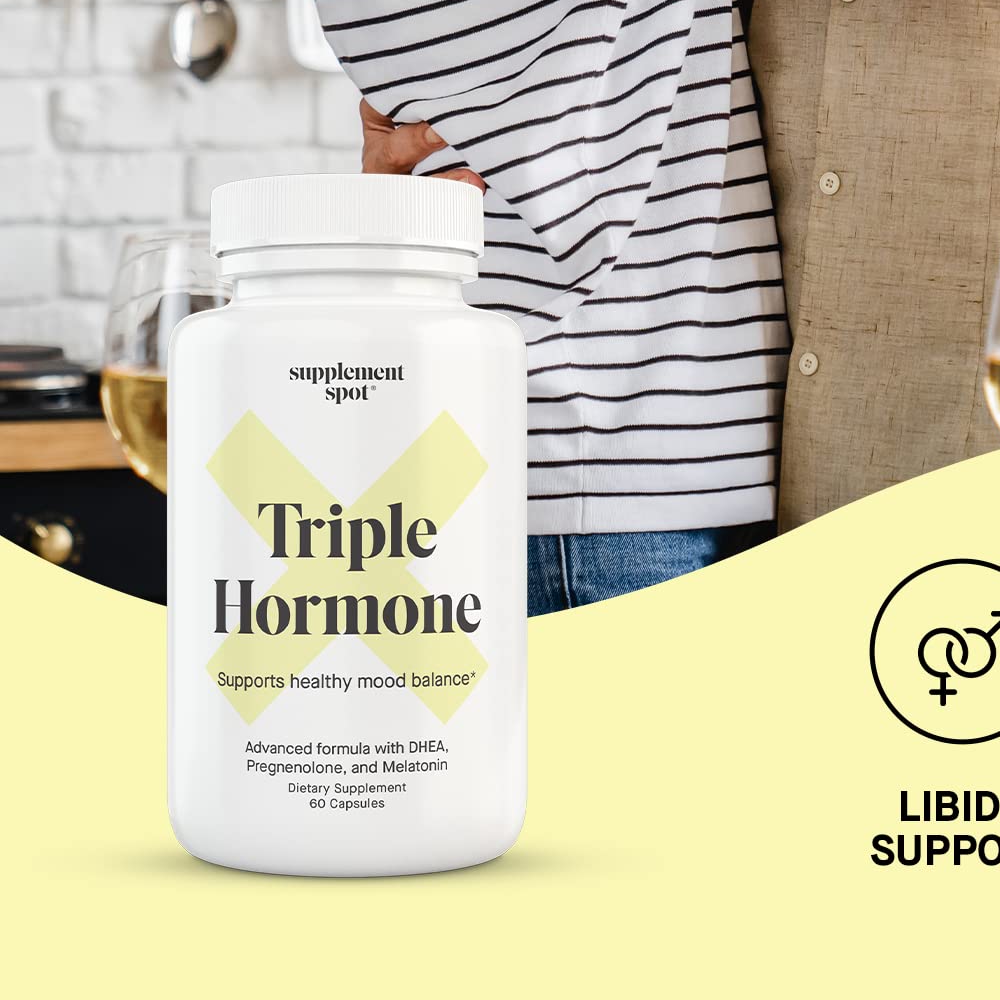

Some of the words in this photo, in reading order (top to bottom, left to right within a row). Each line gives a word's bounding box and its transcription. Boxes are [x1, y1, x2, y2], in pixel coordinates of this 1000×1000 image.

[289, 361, 405, 383] supplement
[257, 501, 438, 572] Triple
[213, 579, 482, 636] Hormone
[217, 671, 285, 692] Supports
[290, 673, 353, 693] healthy
[357, 672, 406, 689] mood
[244, 740, 313, 756] Advanced
[315, 741, 371, 756] formula
[374, 741, 405, 755] with
[409, 739, 449, 754] DHEA,
[247, 759, 347, 777] Pregnenolone,
[351, 760, 378, 774] and
[382, 758, 448, 774] Melatonin
[288, 782, 331, 796] Dietary
[334, 782, 407, 796] Supplement
[309, 798, 326, 809] 60
[329, 797, 385, 812] Capsules
